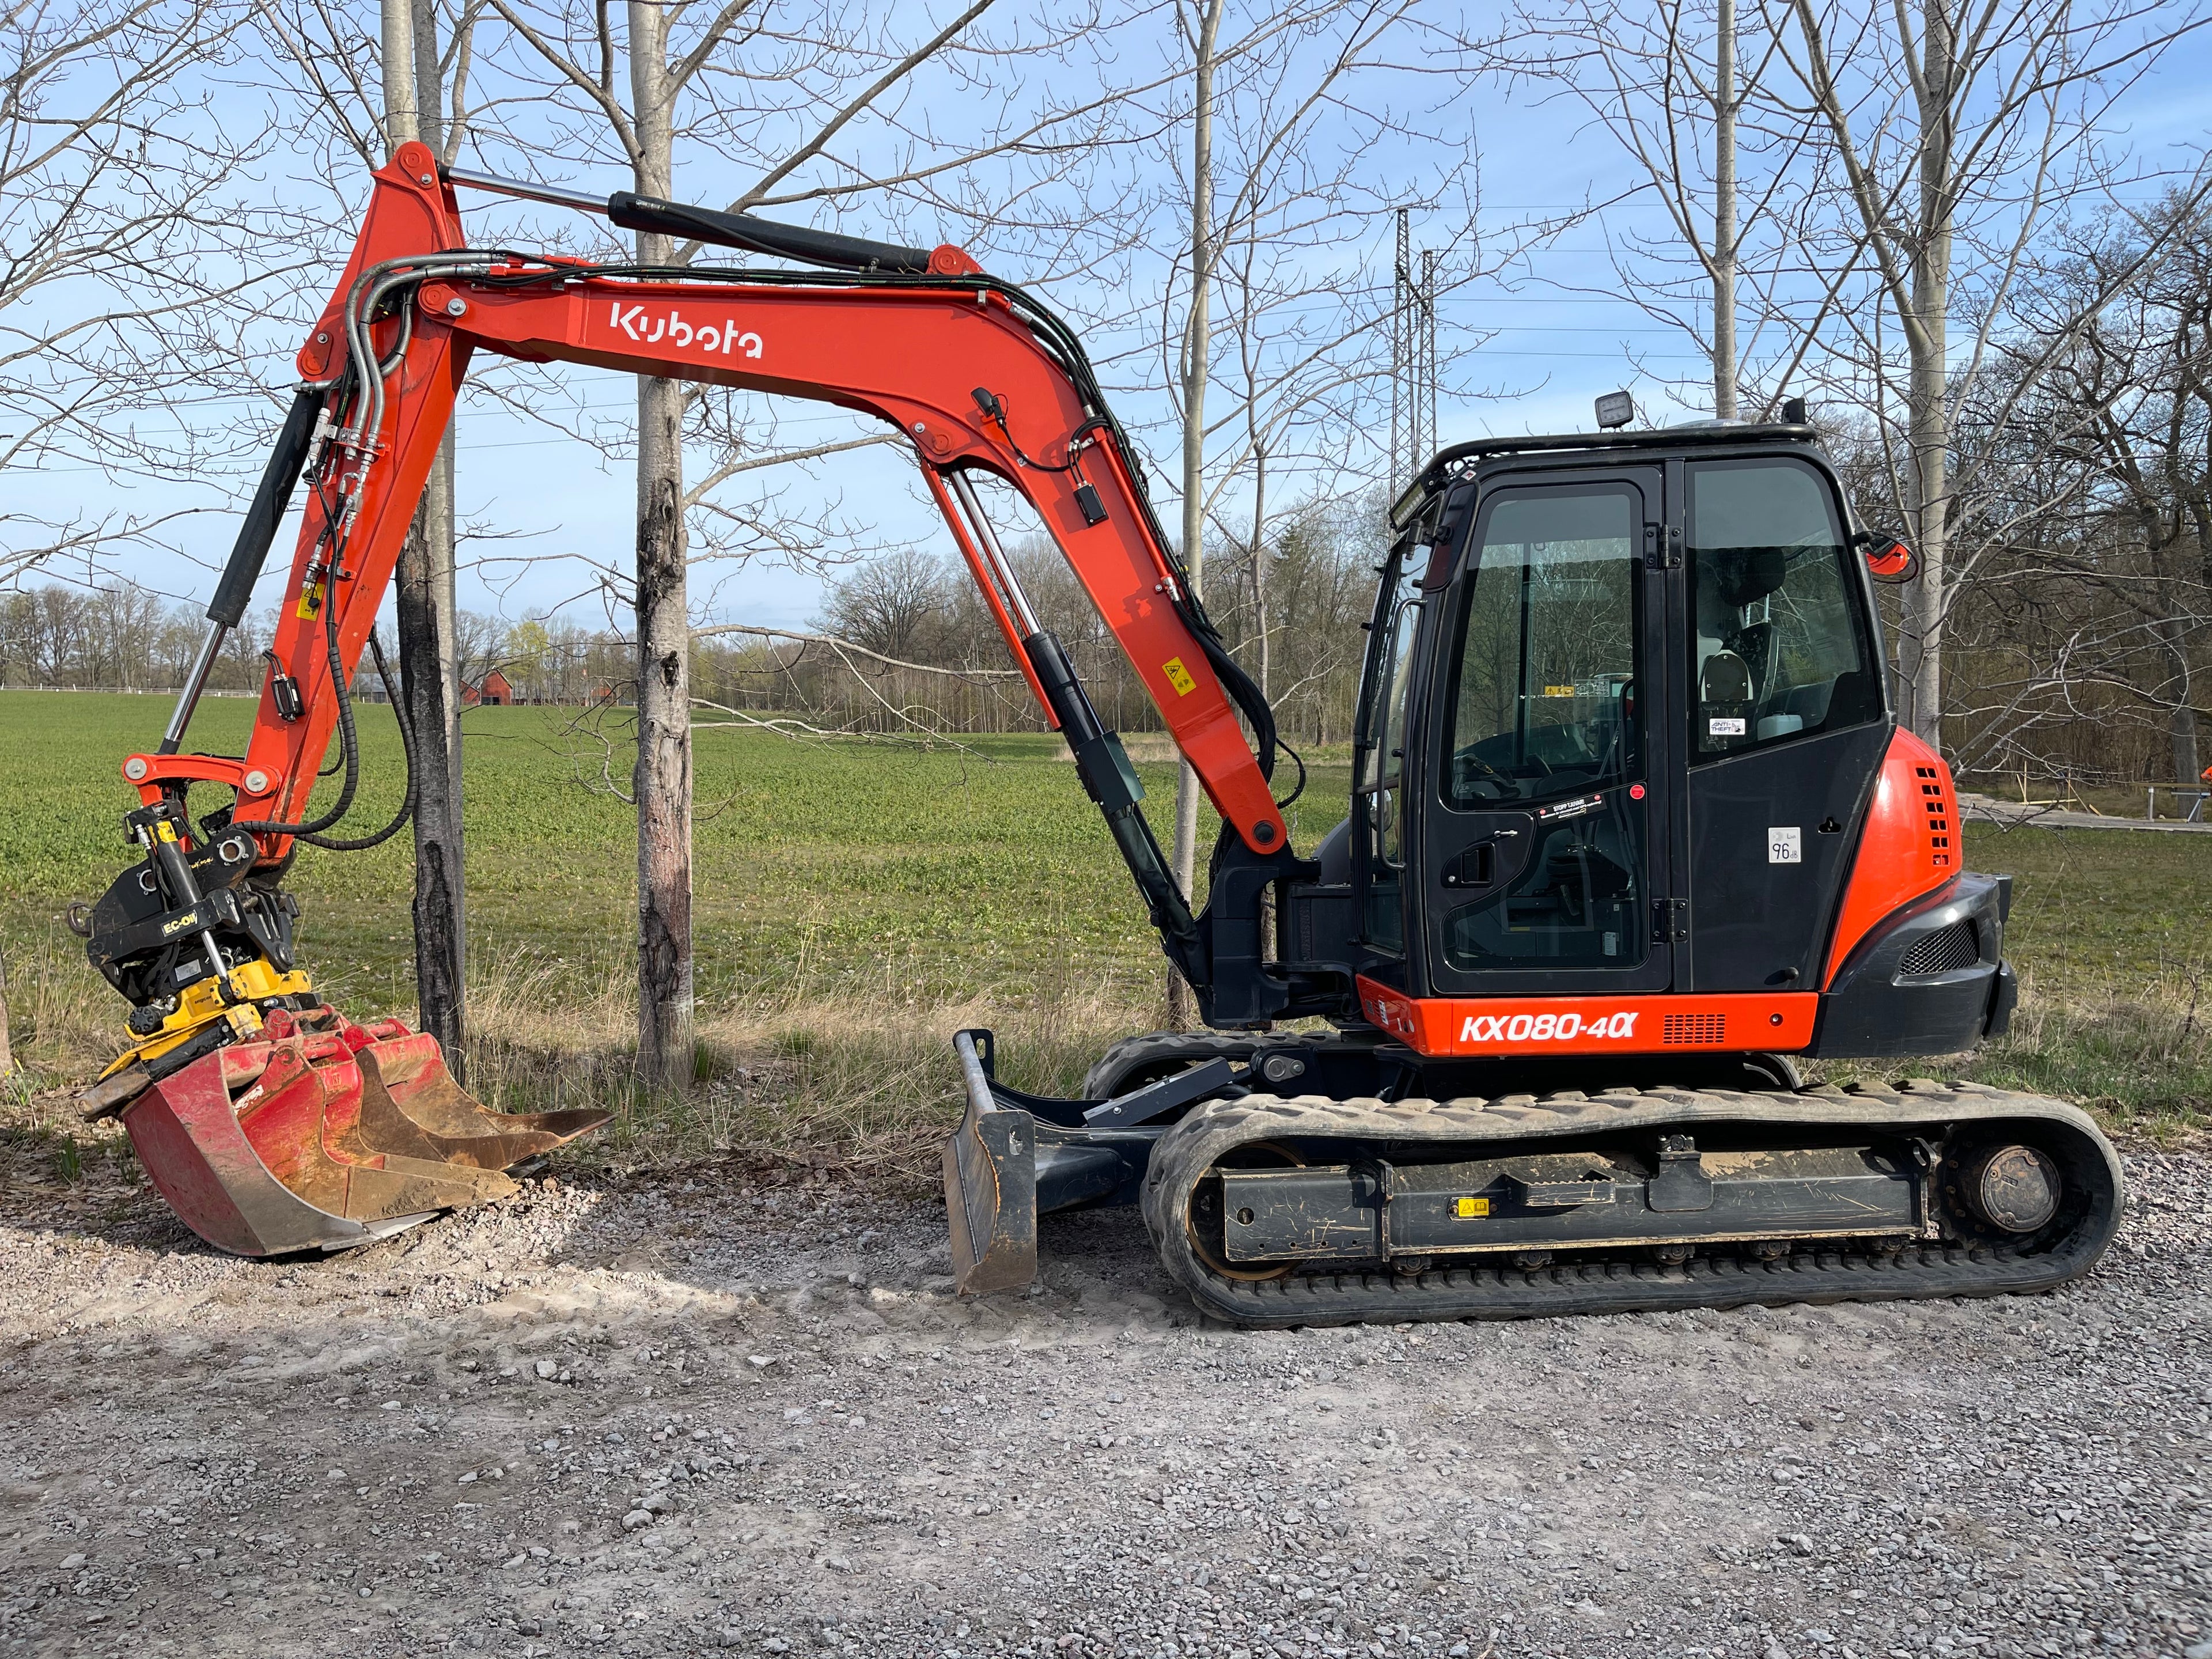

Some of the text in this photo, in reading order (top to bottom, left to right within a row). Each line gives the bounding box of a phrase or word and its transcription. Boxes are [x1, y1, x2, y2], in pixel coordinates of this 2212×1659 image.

[610, 302, 763, 358] Kubota
[1553, 803, 1567, 812] STOPP
[1772, 843, 1798, 859] 96 dB
